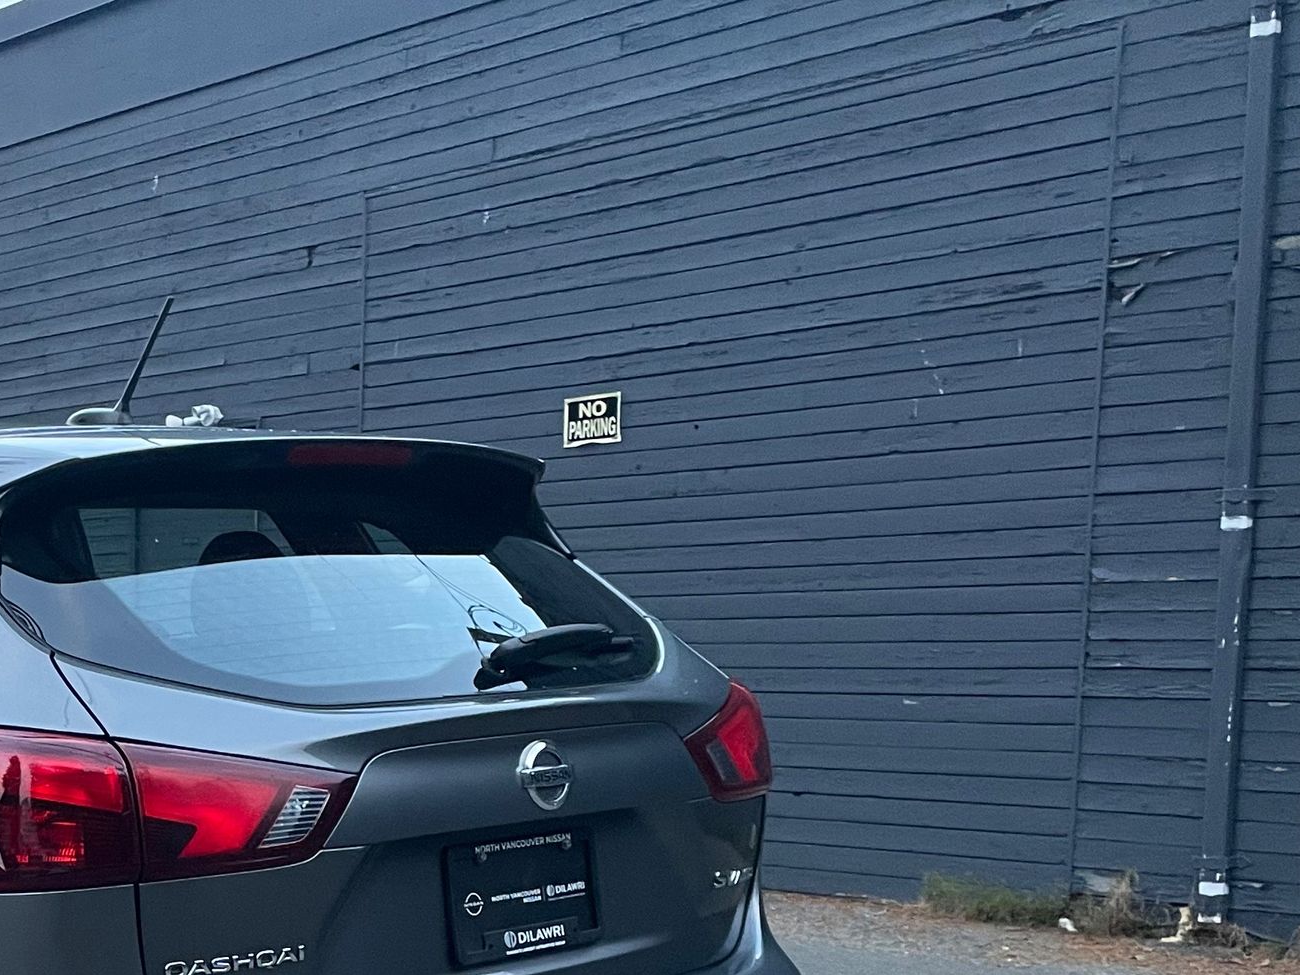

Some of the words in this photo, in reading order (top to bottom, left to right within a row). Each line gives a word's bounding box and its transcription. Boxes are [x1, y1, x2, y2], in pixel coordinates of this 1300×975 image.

[578, 400, 607, 419] NO
[568, 415, 617, 440] PARKING
[530, 769, 572, 784] NISSAN
[475, 843, 501, 854] NORTH
[501, 836, 545, 850] VANCOUVER
[545, 833, 571, 844] NISSAN
[555, 881, 586, 894] DILAWRI
[517, 924, 565, 944] DILAWRI
